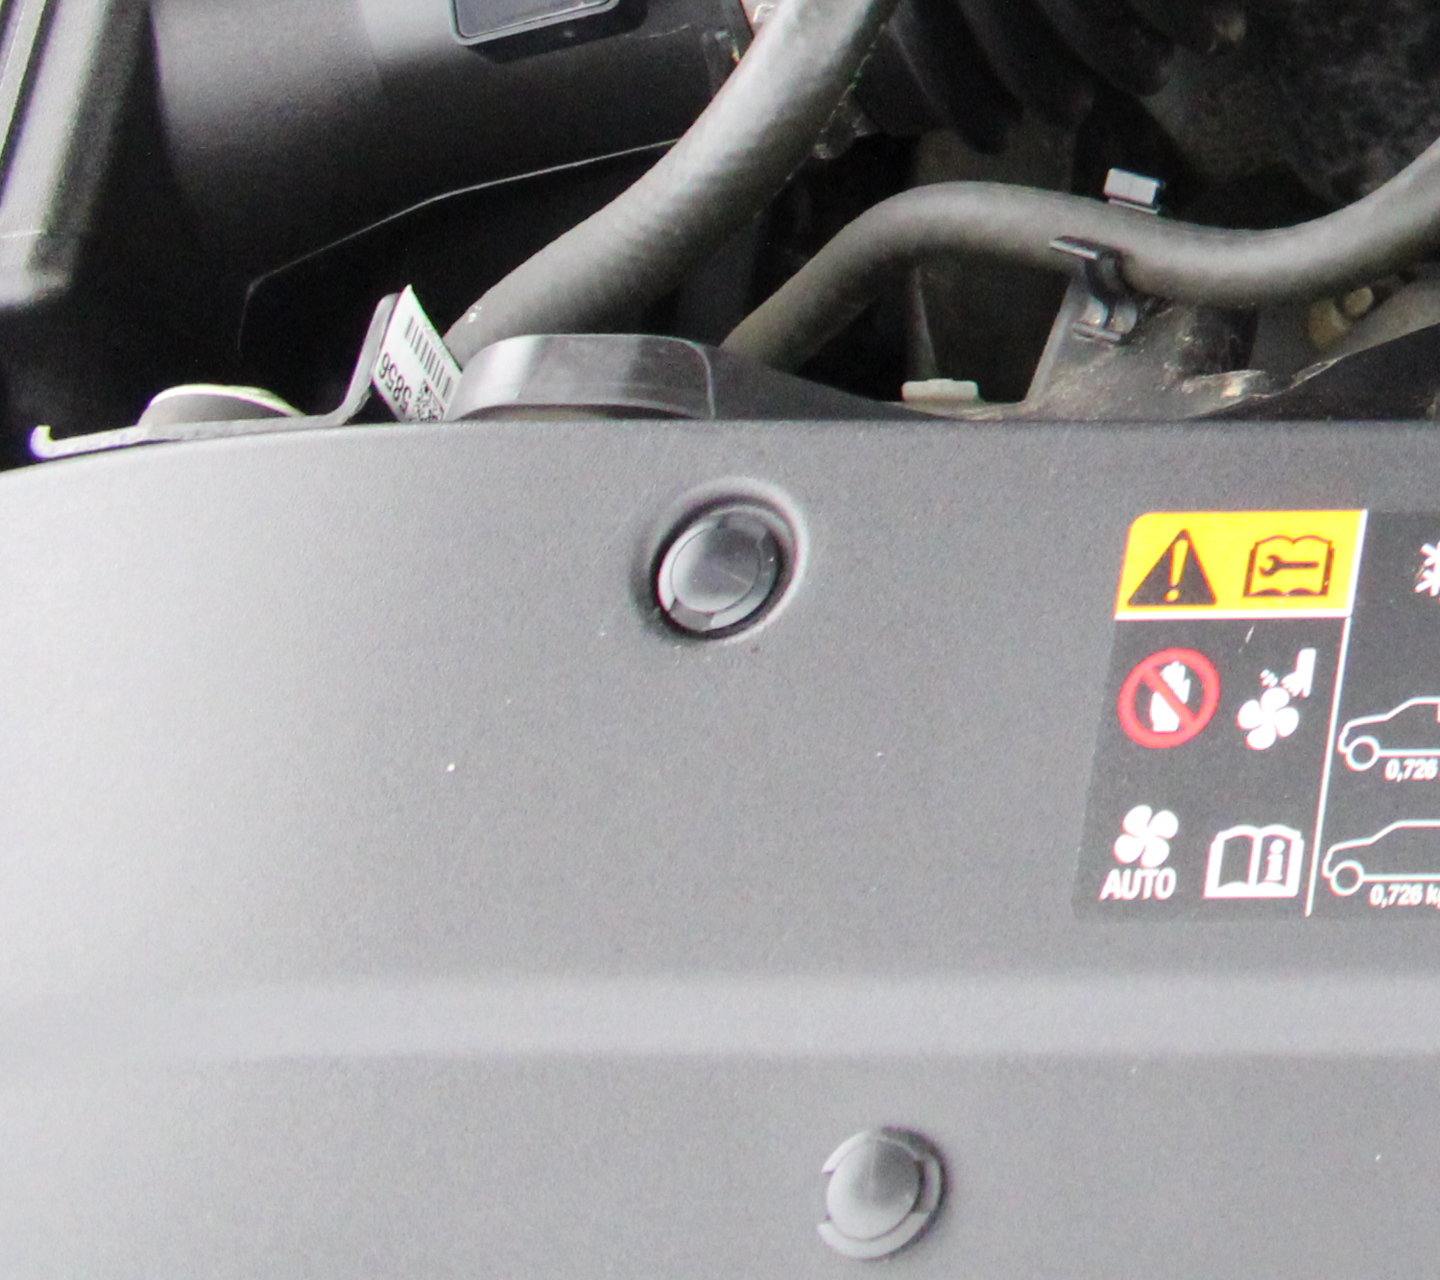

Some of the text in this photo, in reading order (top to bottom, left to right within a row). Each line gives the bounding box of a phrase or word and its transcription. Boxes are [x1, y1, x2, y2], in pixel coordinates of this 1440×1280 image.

[1385, 758, 1438, 782] 0,726
[1098, 867, 1177, 900] AUTO
[1369, 883, 1424, 908] 0,726
